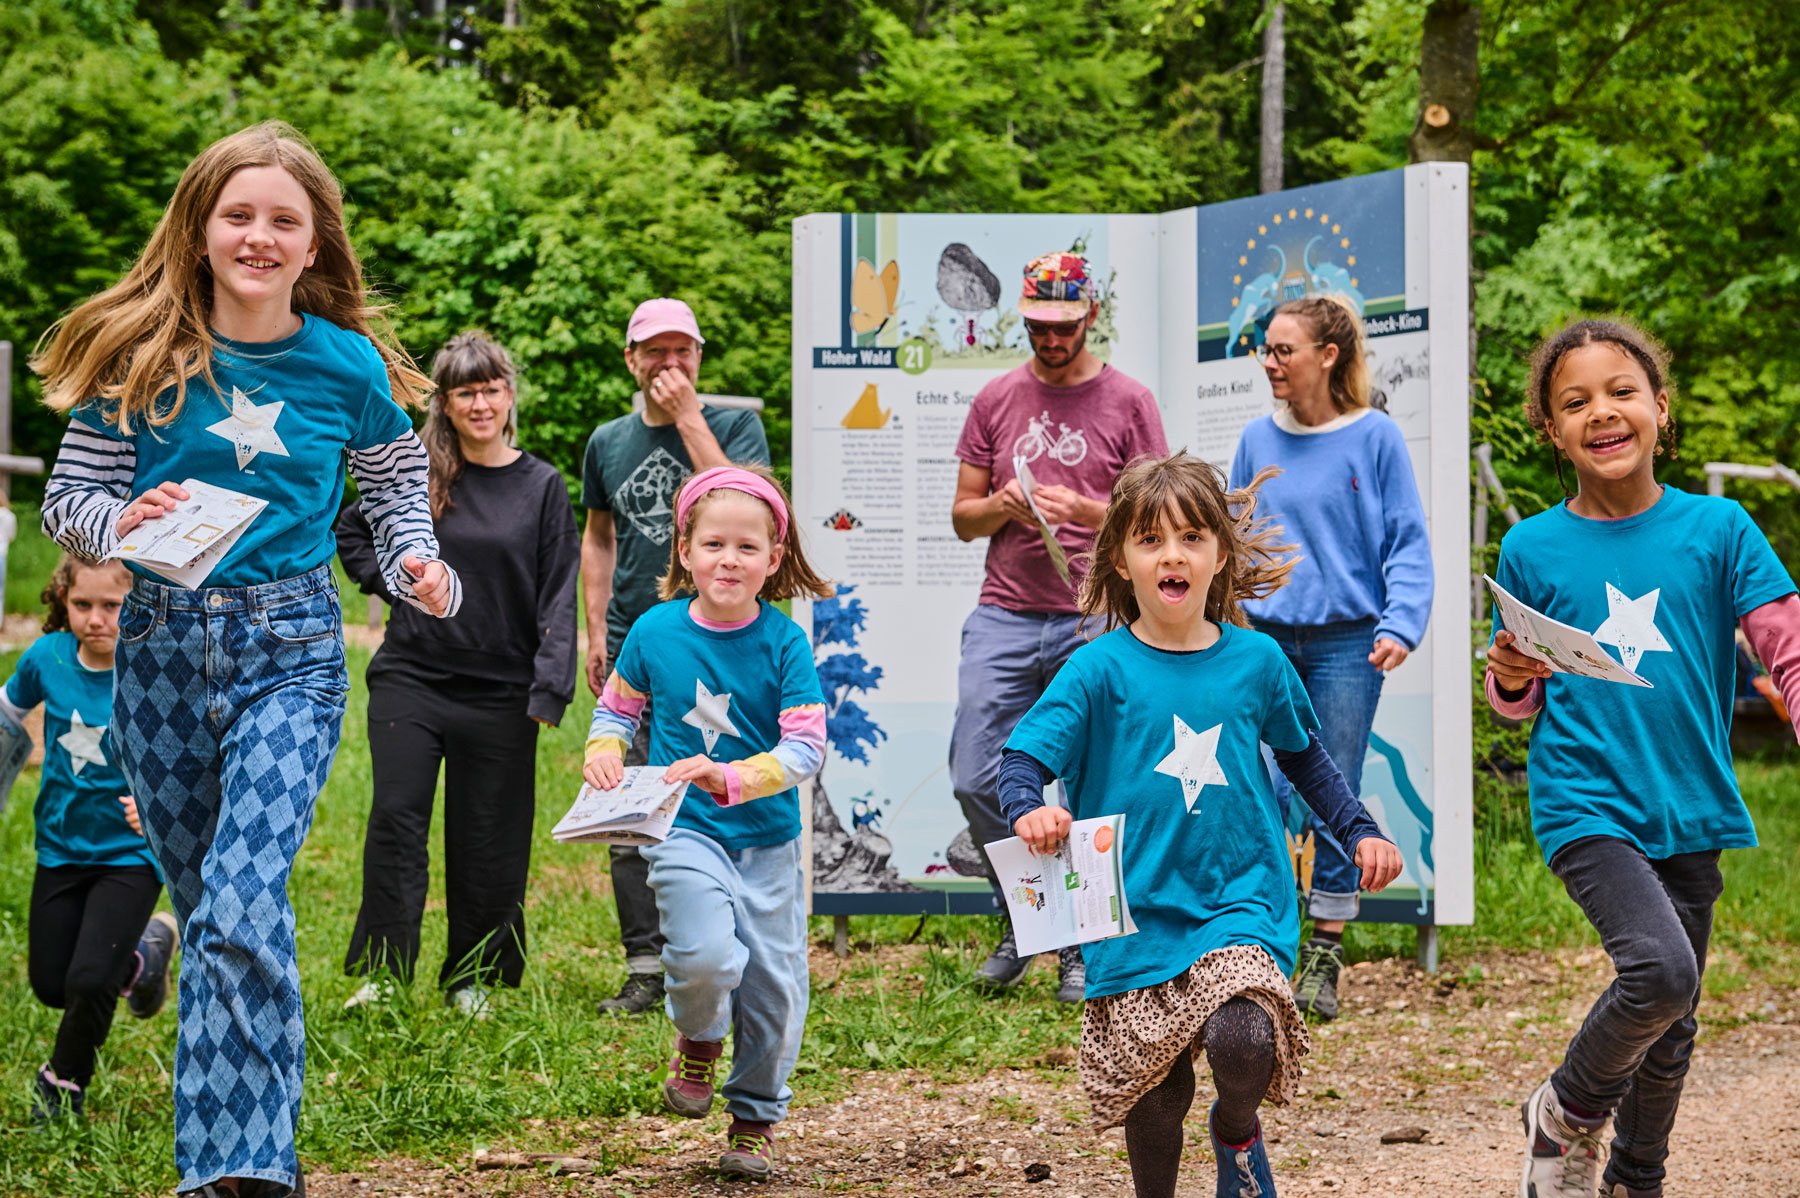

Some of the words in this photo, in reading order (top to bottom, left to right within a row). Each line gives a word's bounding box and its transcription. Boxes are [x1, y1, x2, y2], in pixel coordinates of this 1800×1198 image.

[822, 349, 857, 366] Hoher
[860, 349, 892, 366] Wald
[904, 346, 924, 369] 21
[916, 391, 949, 405] Echte
